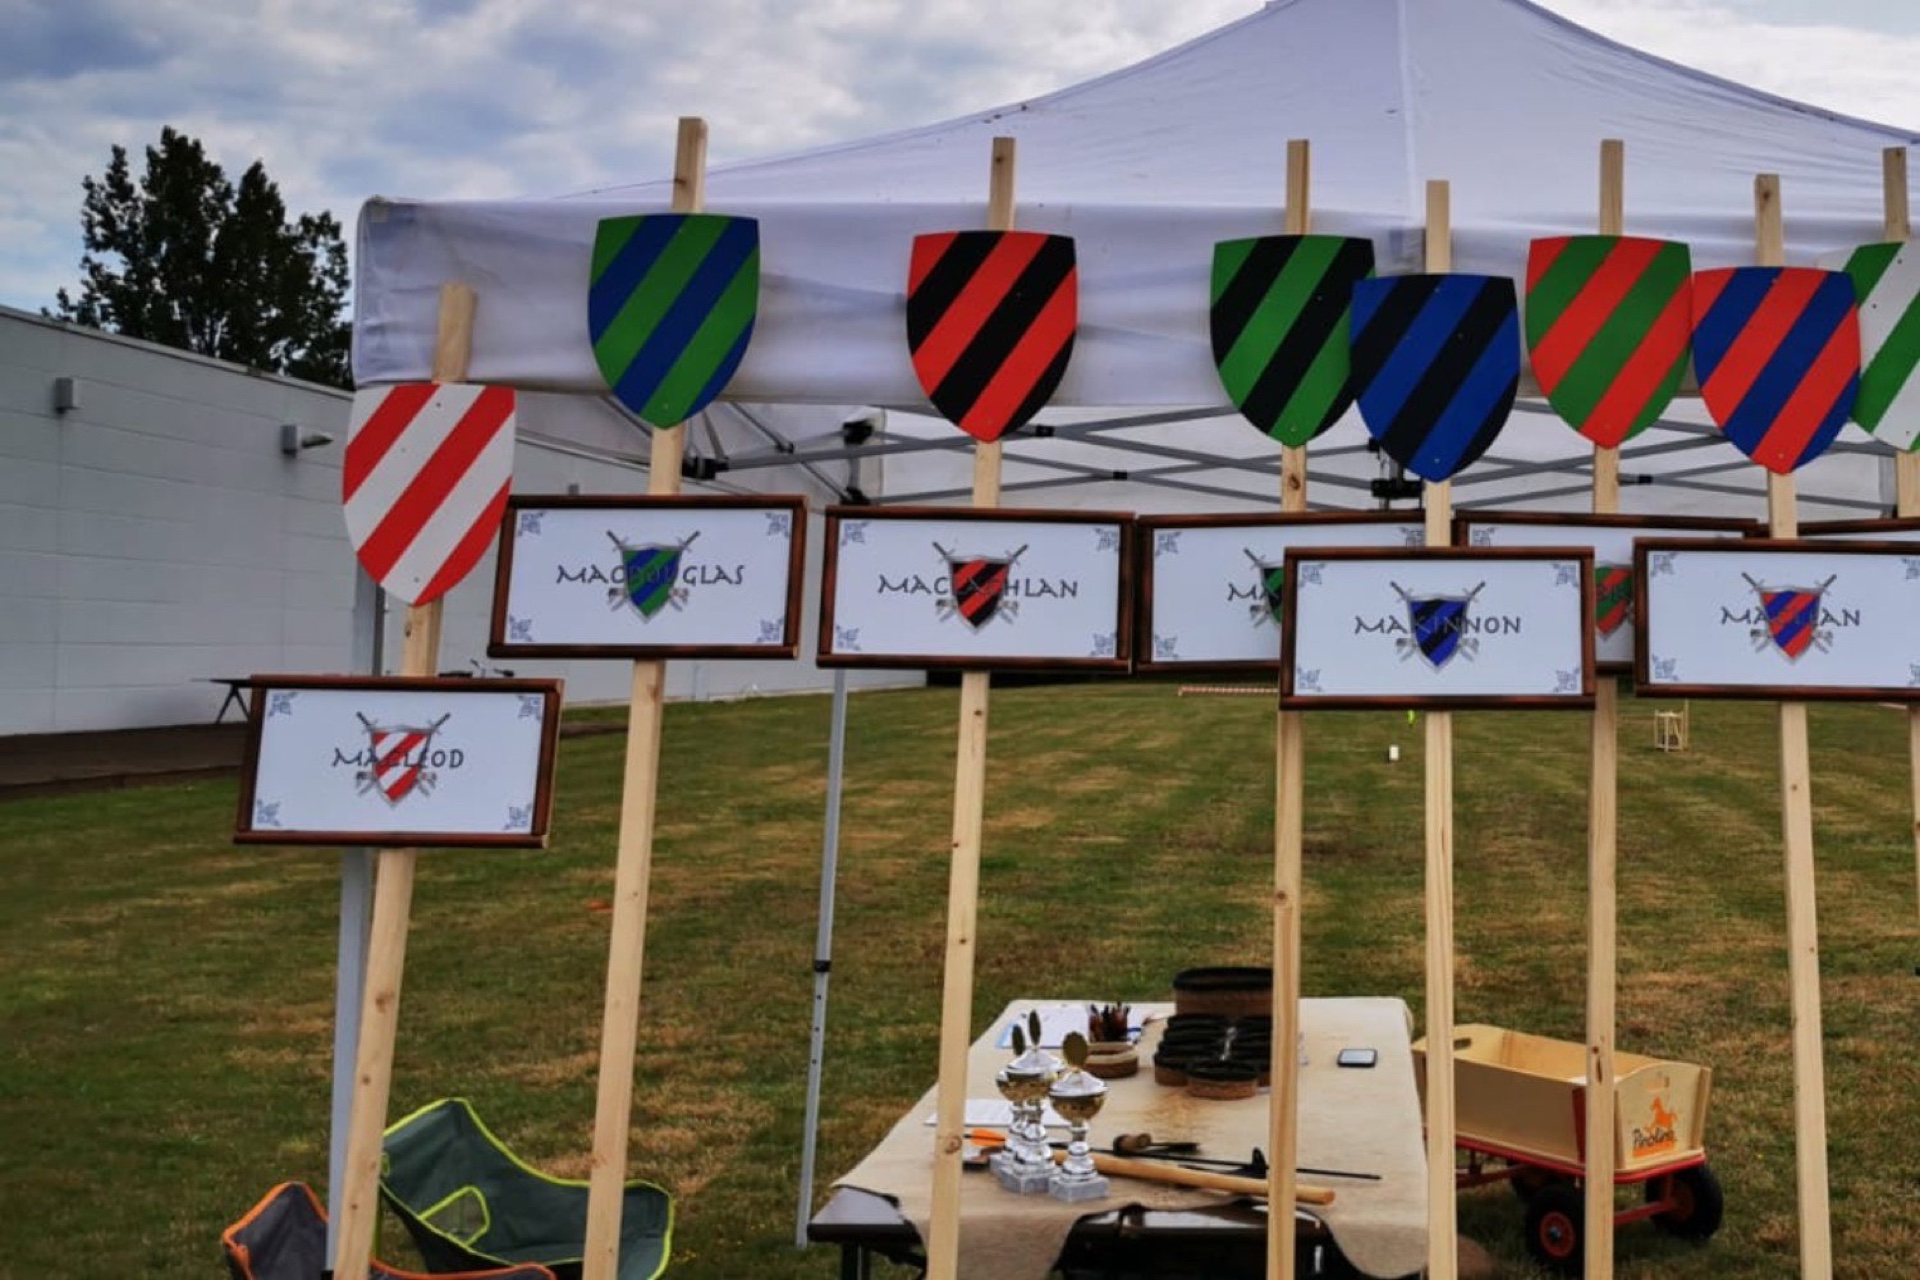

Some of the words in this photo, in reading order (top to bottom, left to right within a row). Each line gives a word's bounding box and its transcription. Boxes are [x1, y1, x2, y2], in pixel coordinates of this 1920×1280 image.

[1354, 615, 1521, 635] MAKINNON
[1721, 606, 1860, 627] MAAN
[331, 747, 465, 769] MACLEOD
